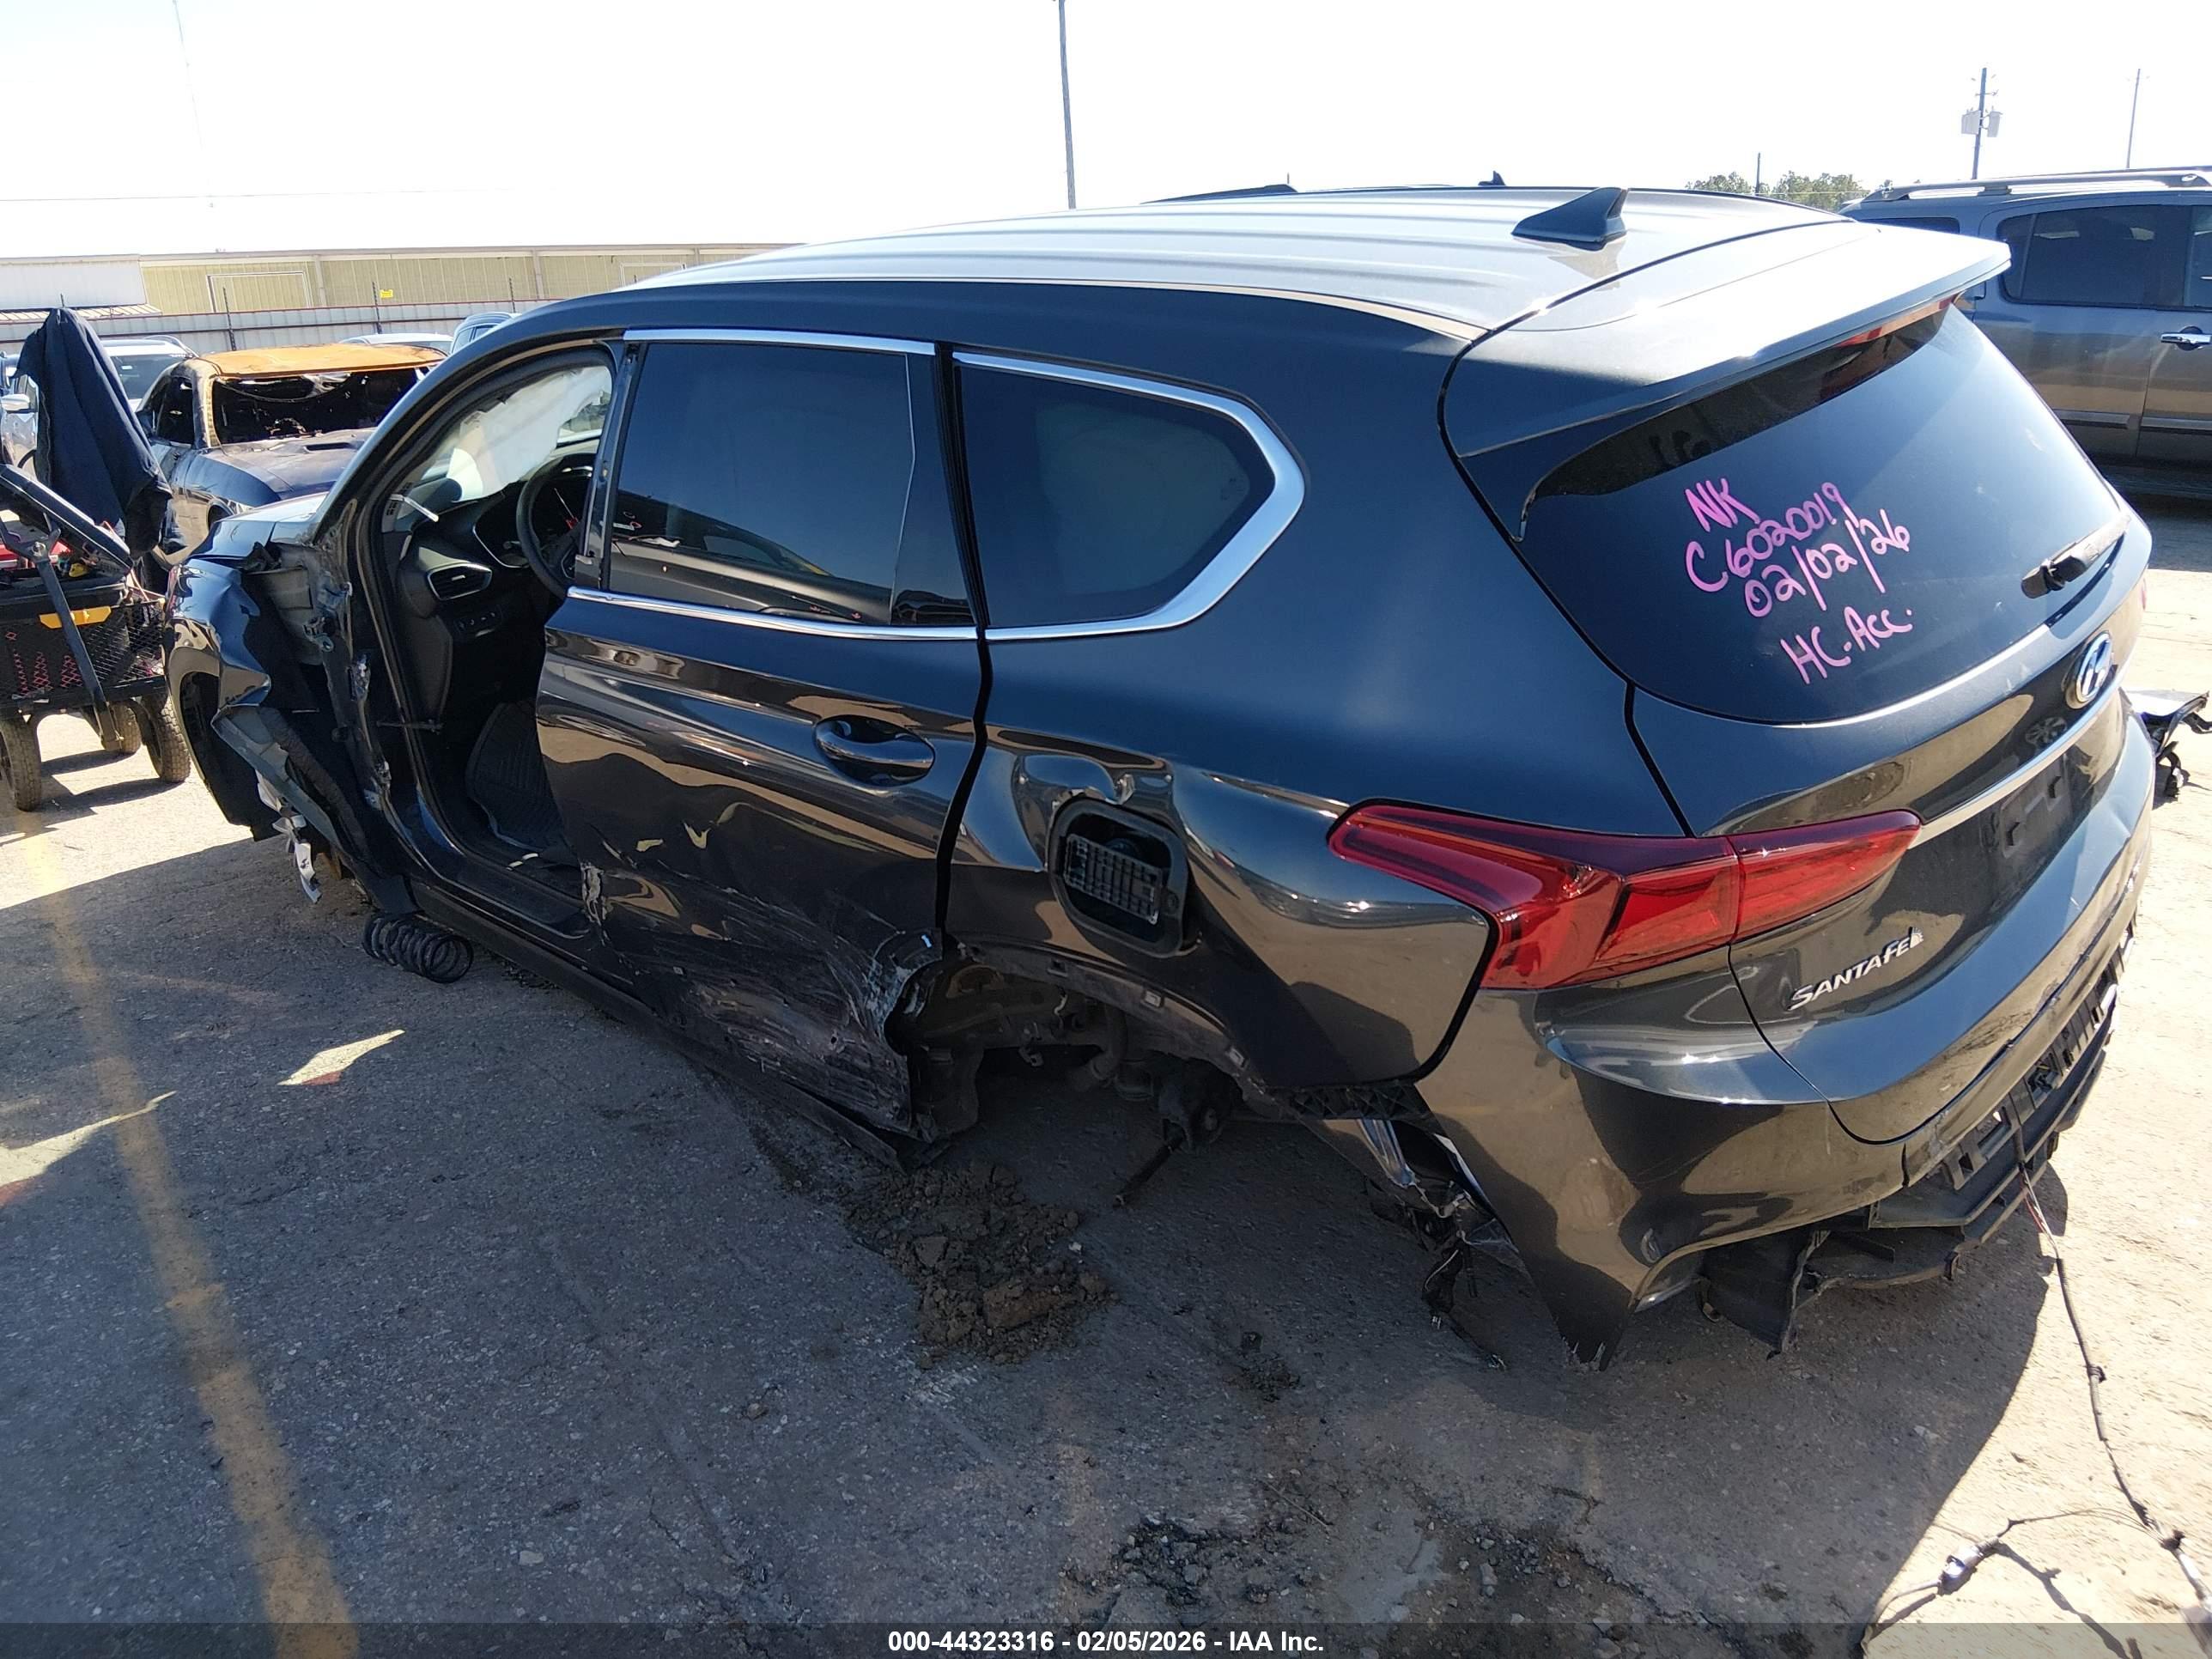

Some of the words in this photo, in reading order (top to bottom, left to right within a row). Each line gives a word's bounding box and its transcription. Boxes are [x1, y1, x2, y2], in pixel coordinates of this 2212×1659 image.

[1685, 477, 1760, 532] NK
[1686, 482, 1859, 592] C6020019
[1744, 508, 1911, 617] 02/02/26
